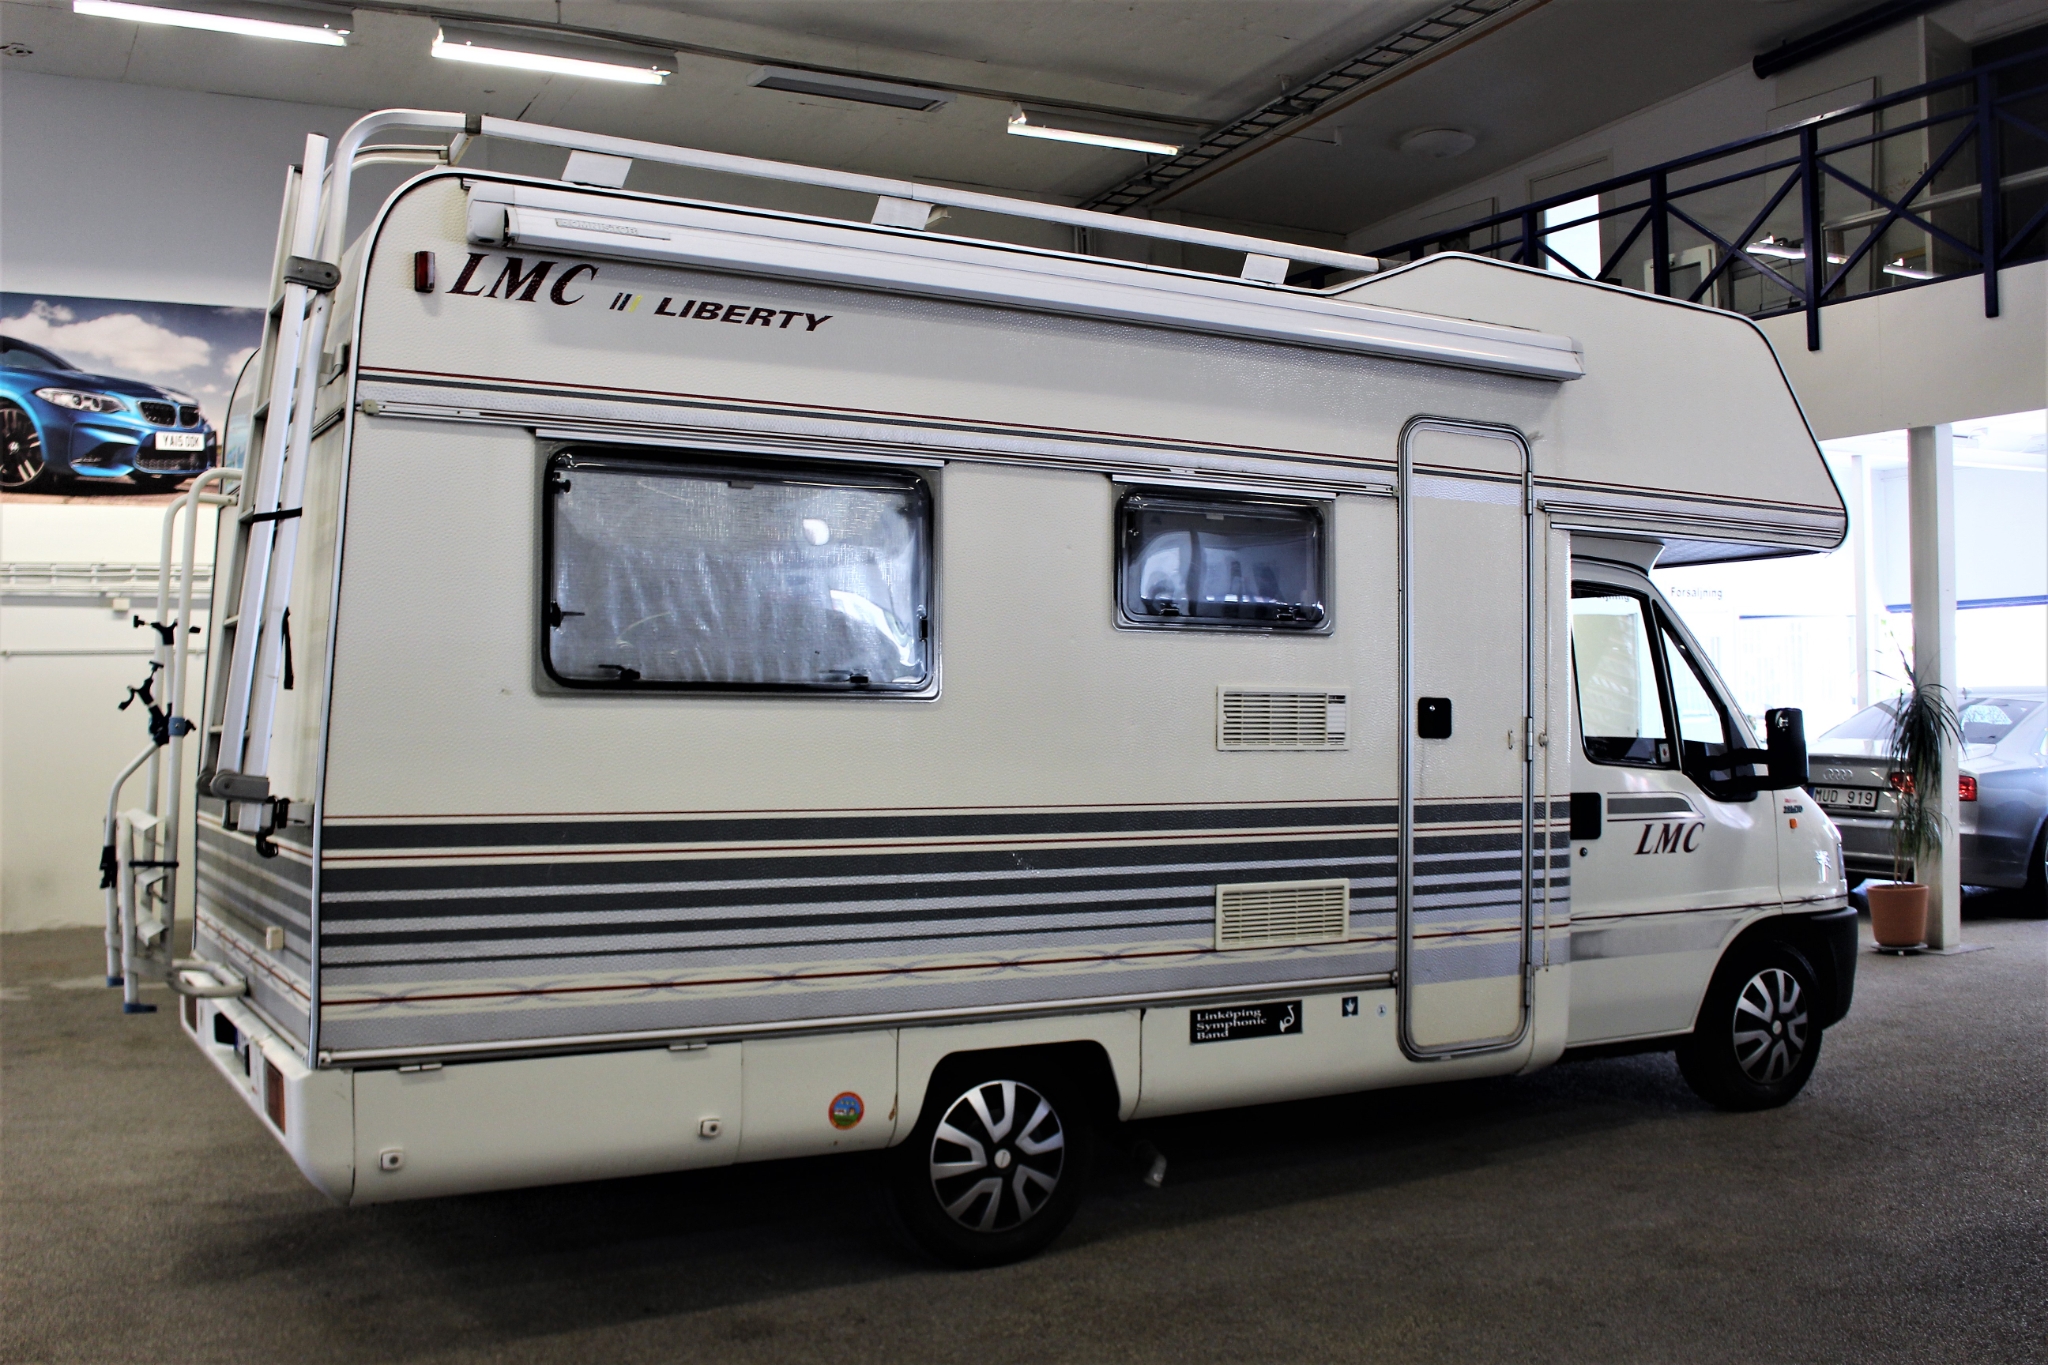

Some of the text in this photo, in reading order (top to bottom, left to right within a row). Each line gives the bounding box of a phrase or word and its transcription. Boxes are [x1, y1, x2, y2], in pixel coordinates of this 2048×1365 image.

[446, 252, 833, 332] LMC LIBERTY
[1814, 789, 1873, 805] MUD 919
[1634, 822, 1705, 855] LMC
[1197, 1009, 1261, 1020] Linköping
[1196, 1017, 1267, 1032] Symphonic
[1197, 1031, 1228, 1040] Band
